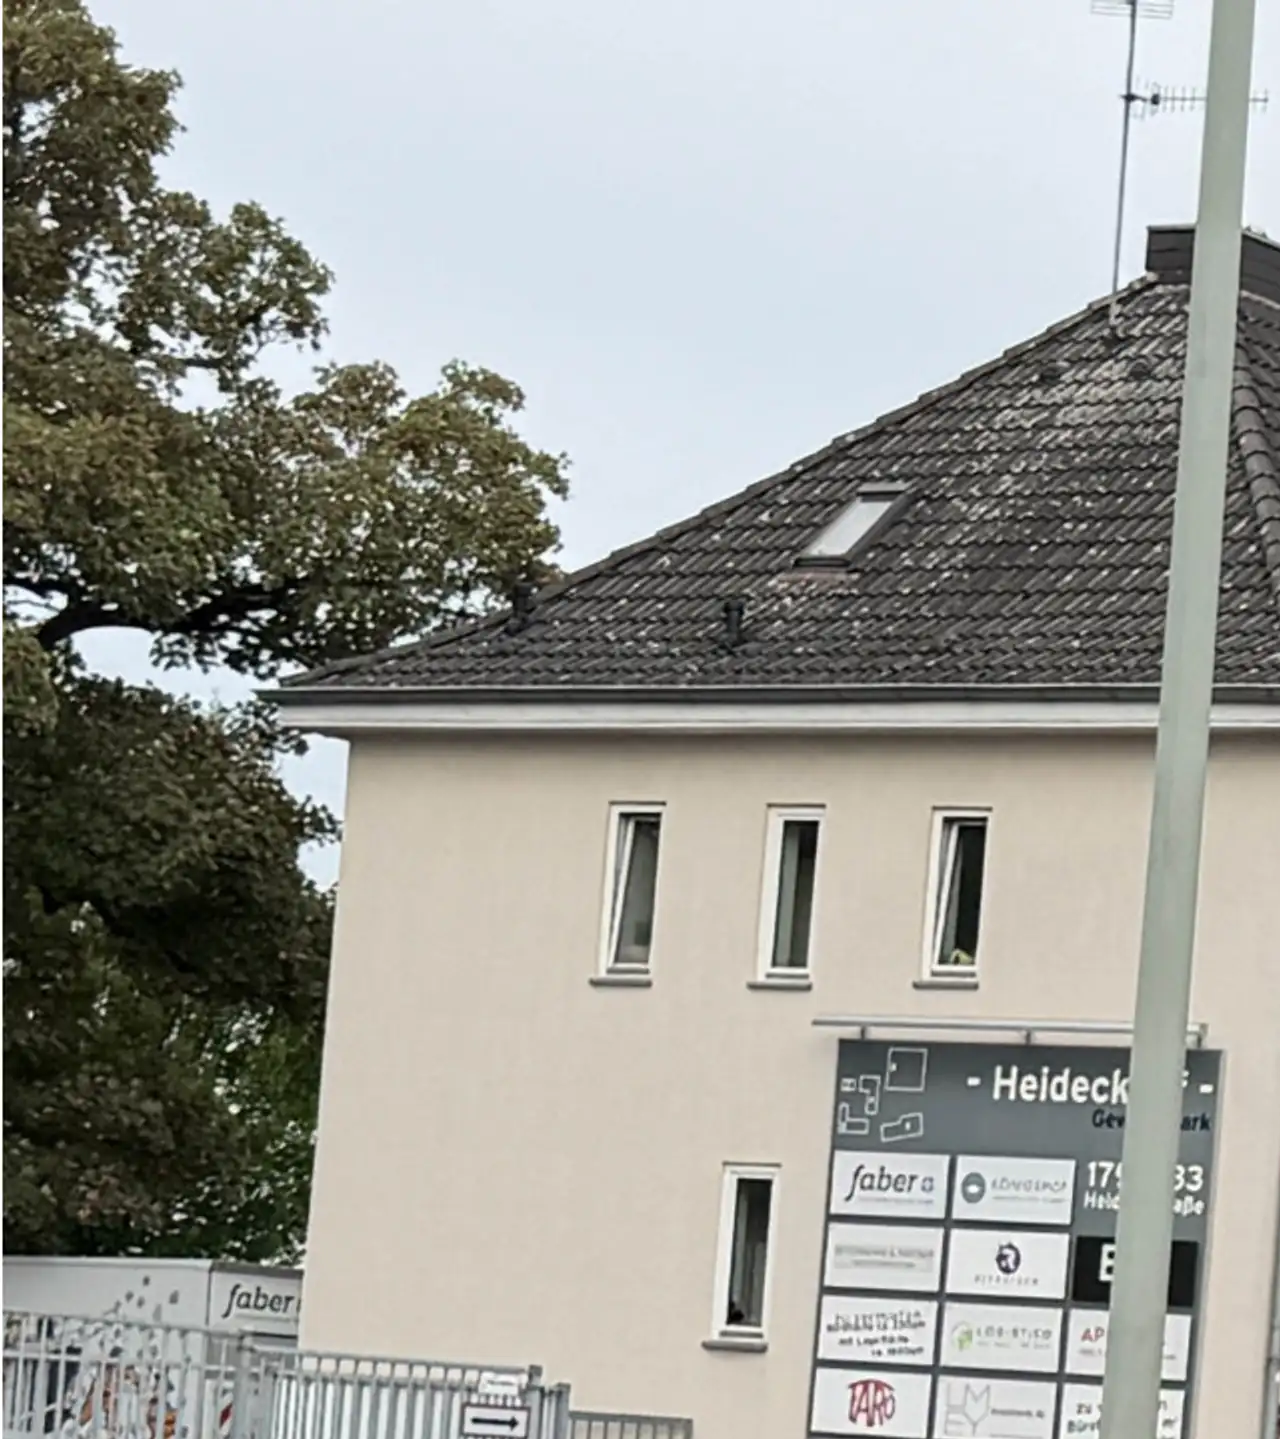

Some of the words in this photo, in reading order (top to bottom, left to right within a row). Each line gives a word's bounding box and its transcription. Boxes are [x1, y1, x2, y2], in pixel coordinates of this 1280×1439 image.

[993, 1065, 1190, 1105] Heideck
[844, 1164, 919, 1202] faber
[221, 1283, 295, 1319] faber
